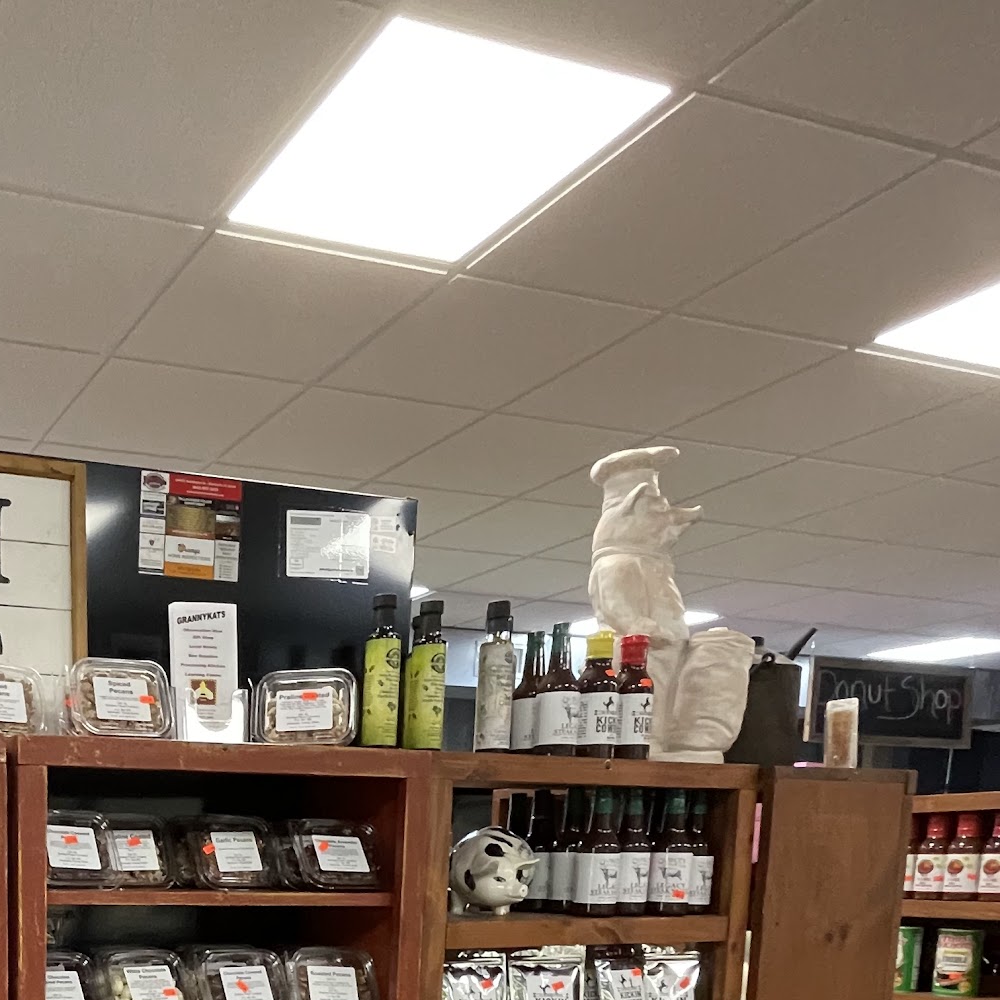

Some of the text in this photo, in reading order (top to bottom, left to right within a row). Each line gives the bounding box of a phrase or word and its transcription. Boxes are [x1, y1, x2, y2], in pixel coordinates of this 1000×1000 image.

[108, 680, 131, 688] Spiced
[820, 668, 962, 724] Donut Shop
[596, 716, 617, 724] KICK
[596, 725, 617, 733] COW
